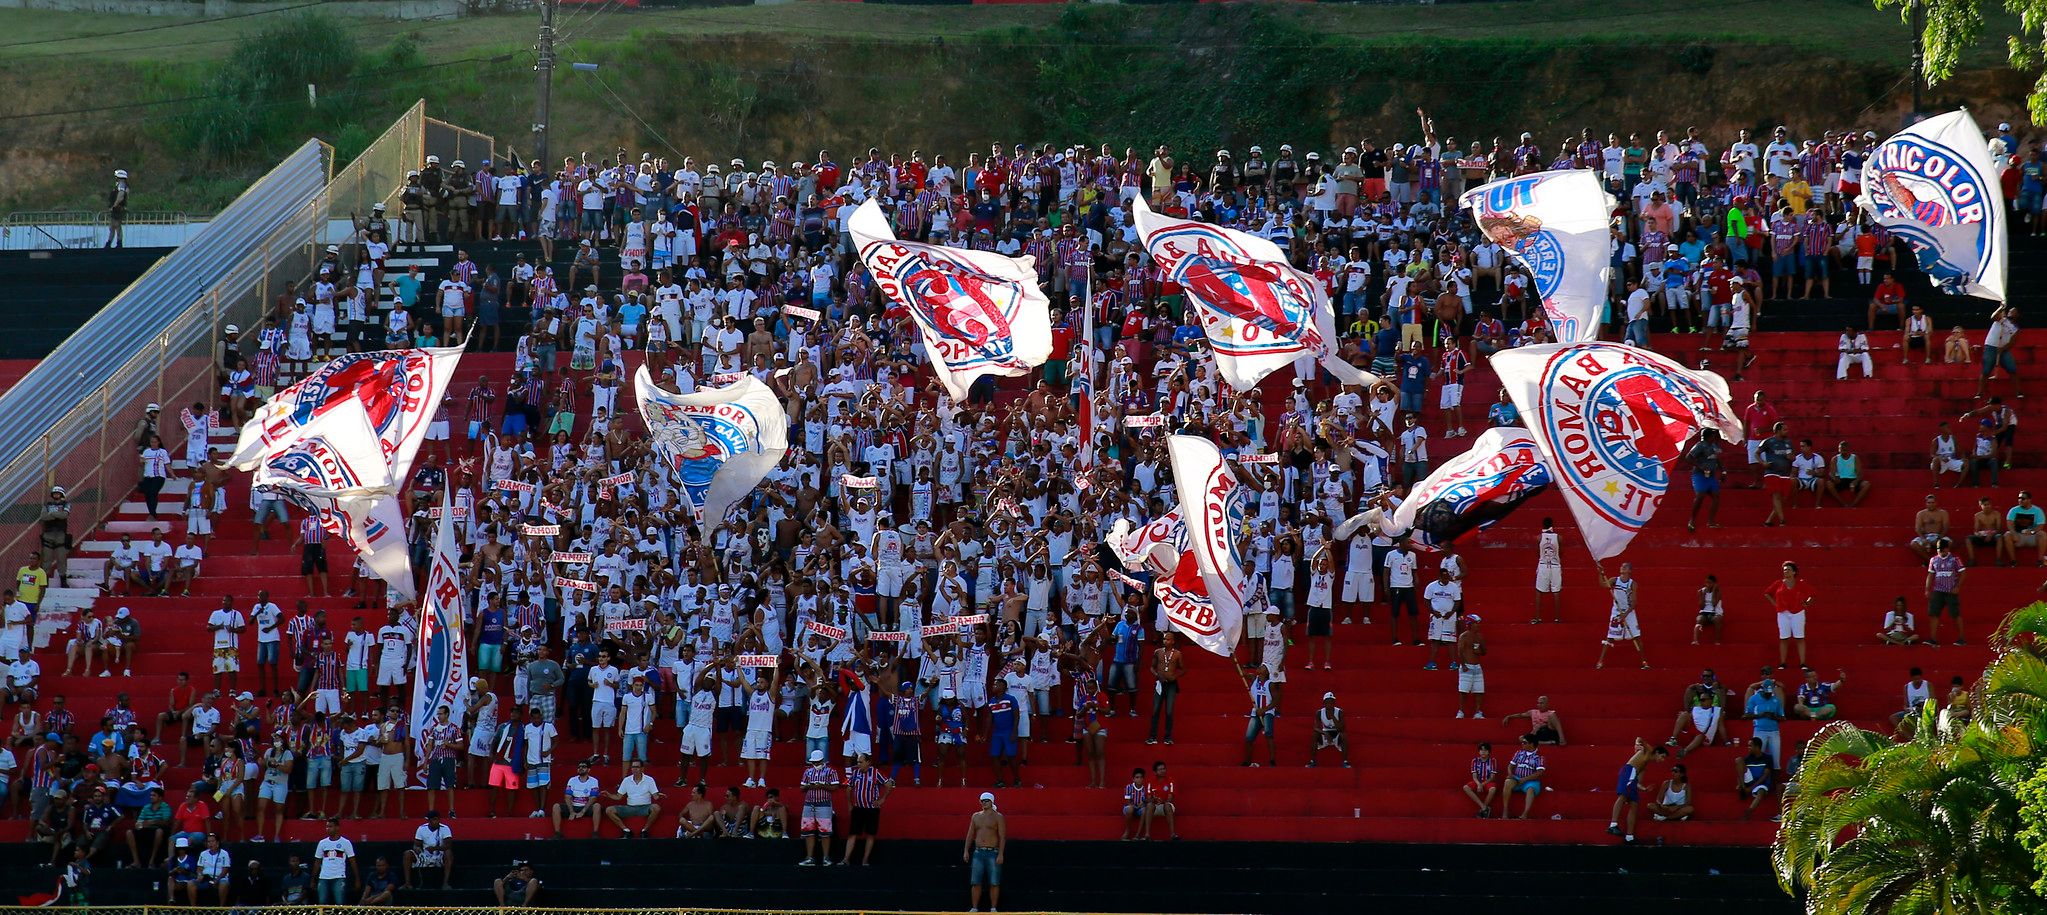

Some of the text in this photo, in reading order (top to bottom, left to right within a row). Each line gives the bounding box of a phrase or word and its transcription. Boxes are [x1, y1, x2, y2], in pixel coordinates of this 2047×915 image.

[786, 306, 818, 320] BAMOR
[1126, 417, 1162, 427] BAMOR
[1240, 454, 1279, 464] BAMOR
[499, 481, 533, 493] BAMOR
[557, 577, 595, 592] BAMOR
[807, 621, 845, 640] BAMOR
[922, 623, 957, 636] BAMOR
[870, 632, 906, 642] BAMOR
[740, 656, 776, 667] BAMOR
